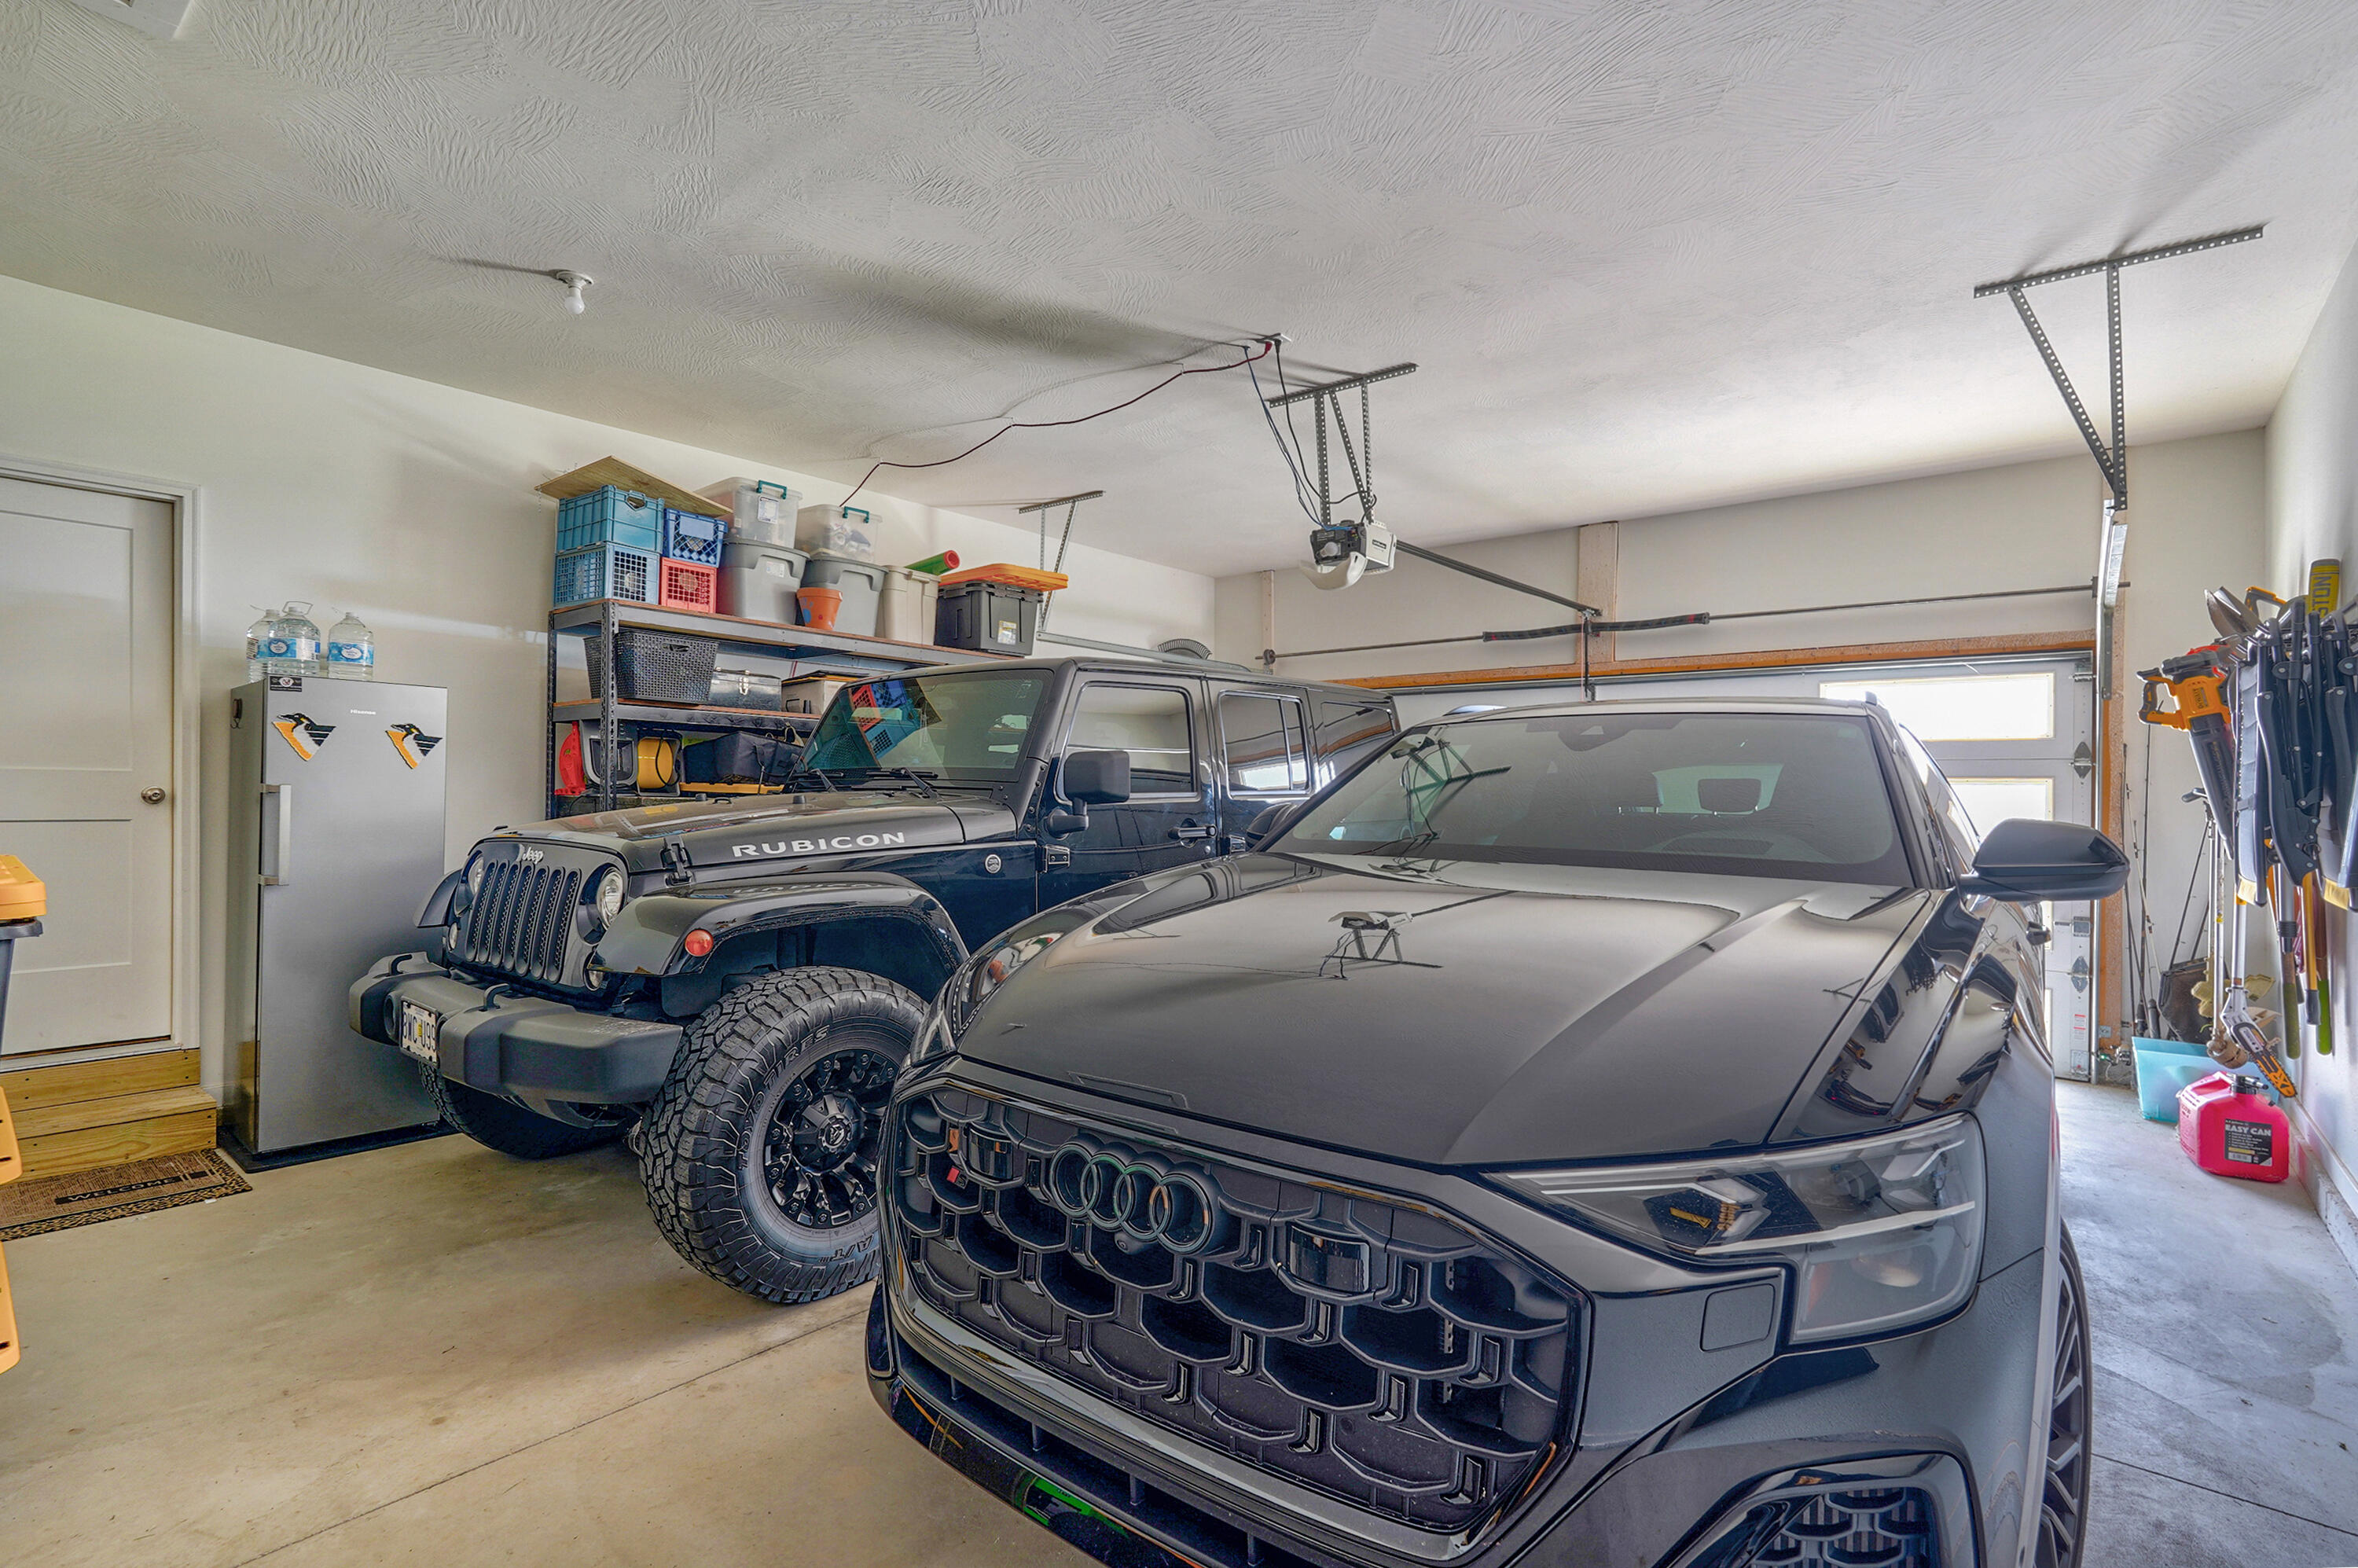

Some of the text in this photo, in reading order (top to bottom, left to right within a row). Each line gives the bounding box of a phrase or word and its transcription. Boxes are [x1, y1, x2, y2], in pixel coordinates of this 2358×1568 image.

[522, 846, 544, 865] Jeep
[732, 832, 905, 857] RUBICON
[763, 1025, 830, 1091] TIRES
[2225, 1124, 2249, 1133] EASY
[2250, 1128, 2272, 1137] CAN
[68, 1177, 176, 1202] WELCOME
